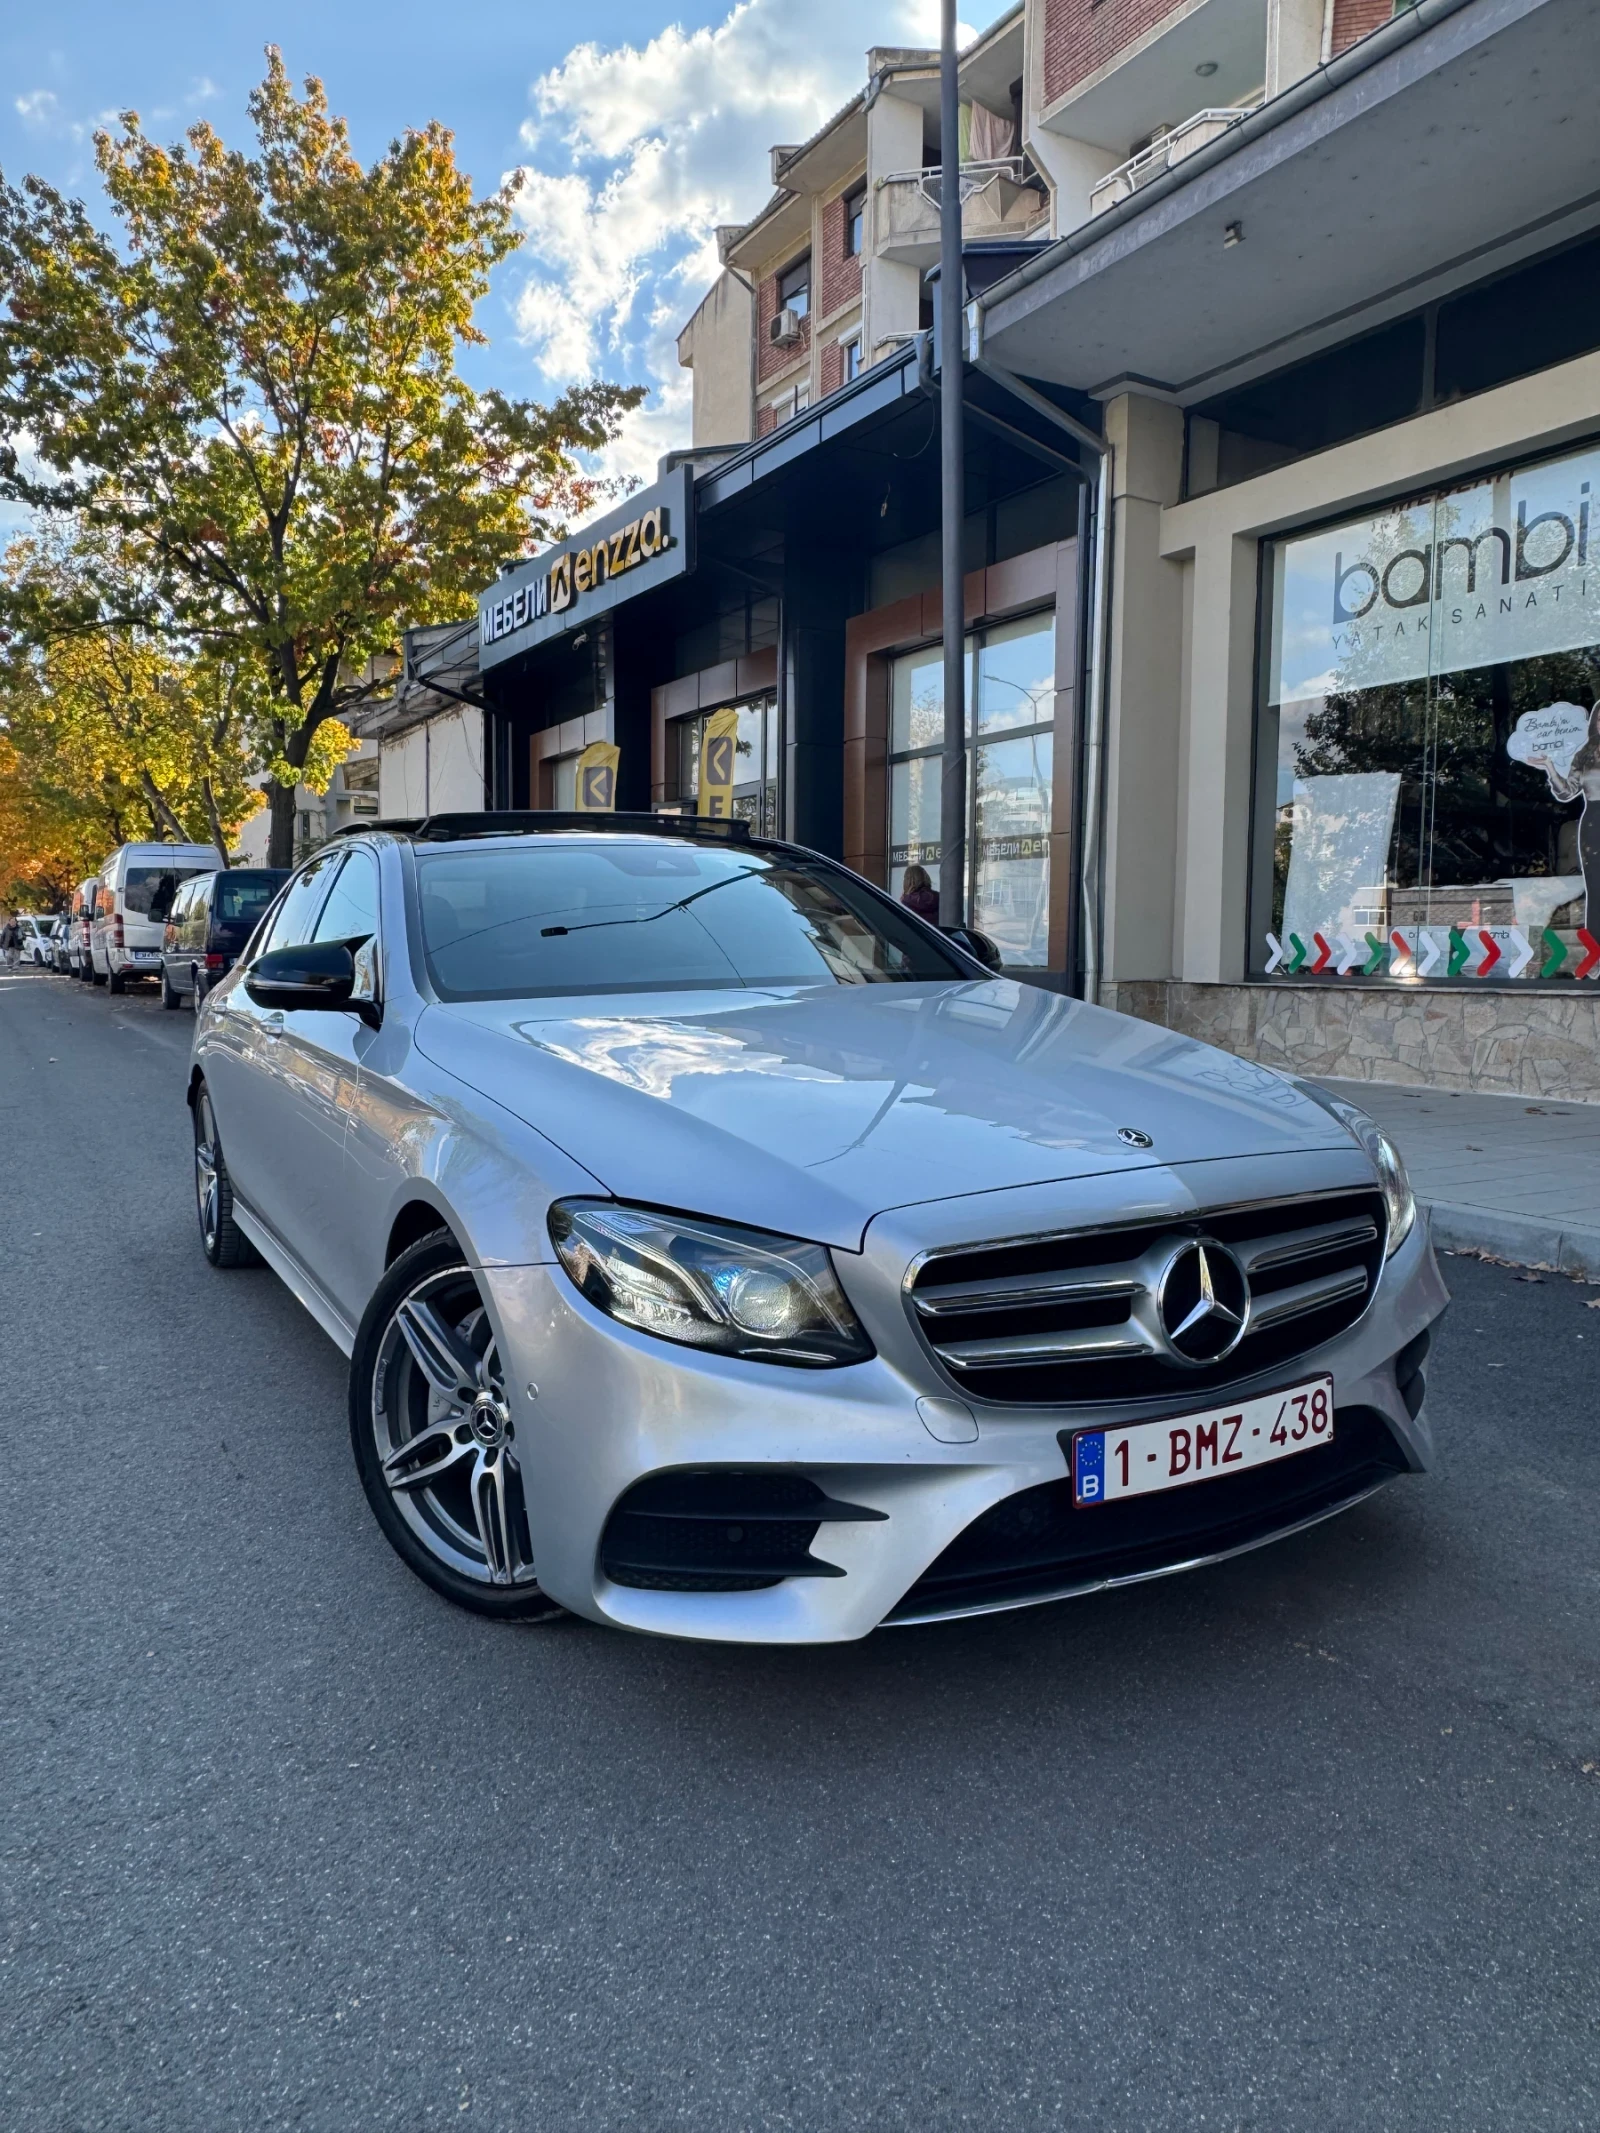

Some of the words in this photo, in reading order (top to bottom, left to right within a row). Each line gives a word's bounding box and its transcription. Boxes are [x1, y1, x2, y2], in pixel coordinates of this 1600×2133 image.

[1333, 481, 1590, 625] bambi
[481, 574, 548, 646] МЕБЕЛИ
[1332, 615, 1430, 650] YATAK
[1451, 579, 1586, 625] SANATI
[1114, 1388, 1328, 1487] 1-BMZ-438
[1082, 1474, 1099, 1498] B
